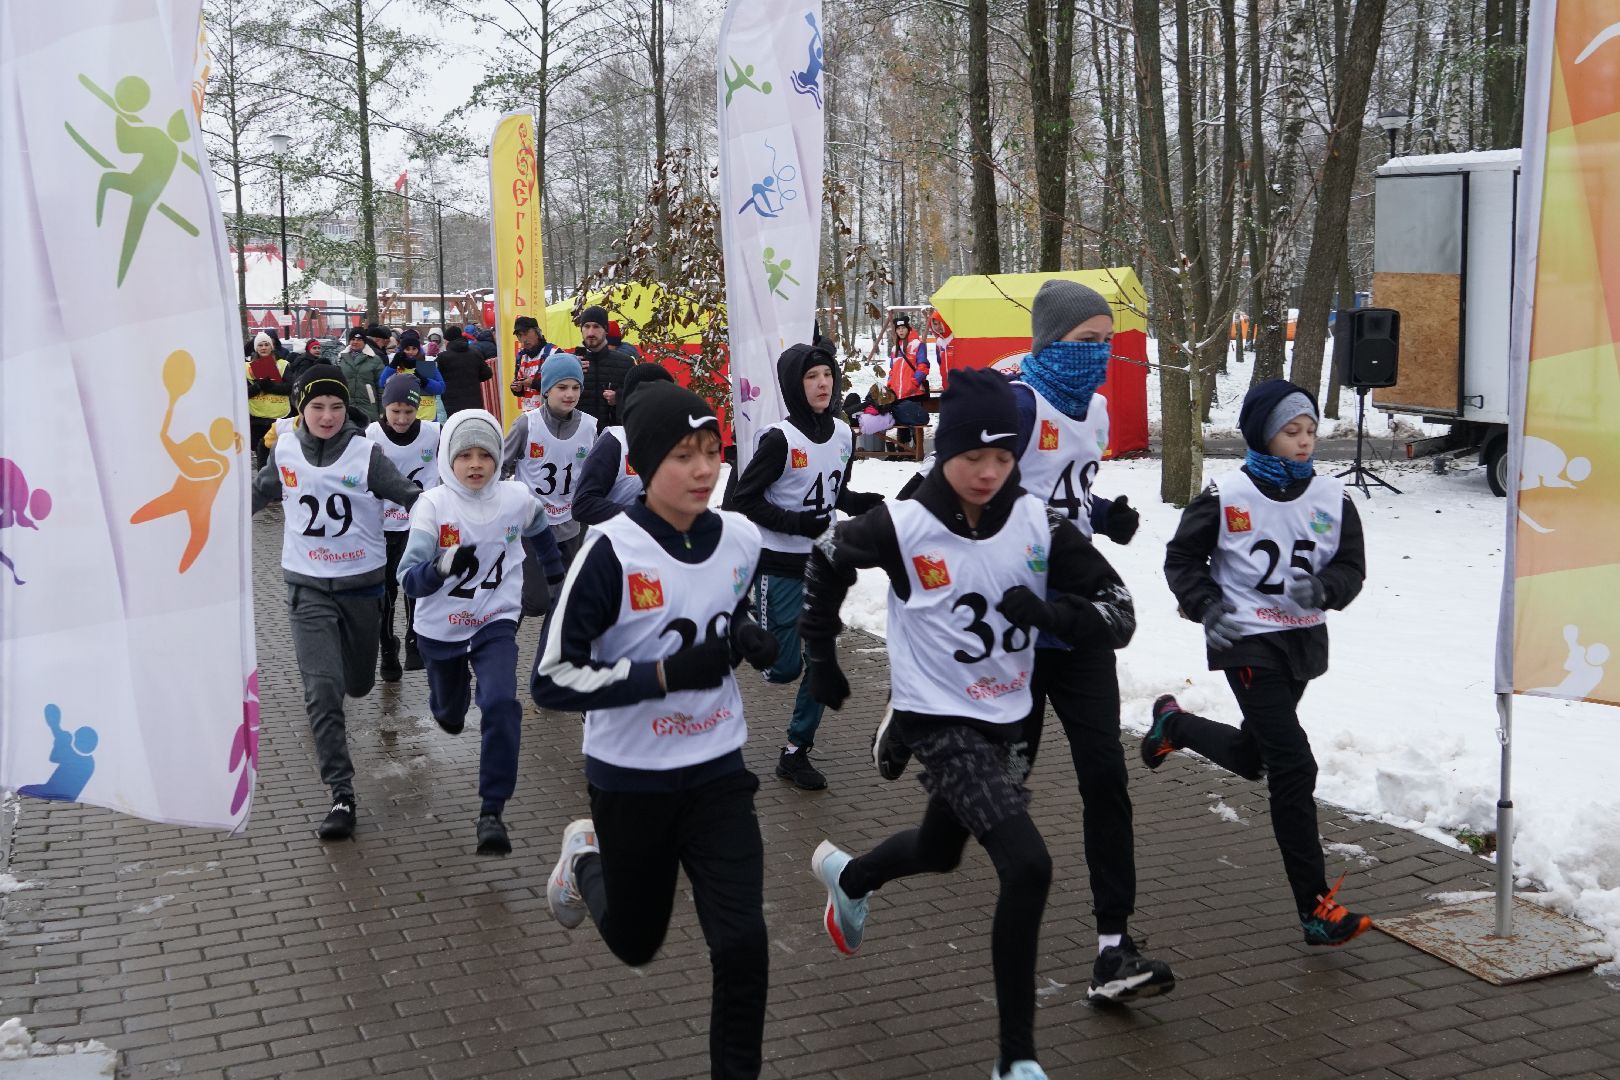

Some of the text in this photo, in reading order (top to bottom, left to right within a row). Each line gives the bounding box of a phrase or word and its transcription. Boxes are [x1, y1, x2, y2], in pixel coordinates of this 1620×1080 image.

[535, 462, 573, 496] 31
[299, 493, 354, 538] 29
[448, 550, 506, 600] 24
[1249, 539, 1316, 595] 25
